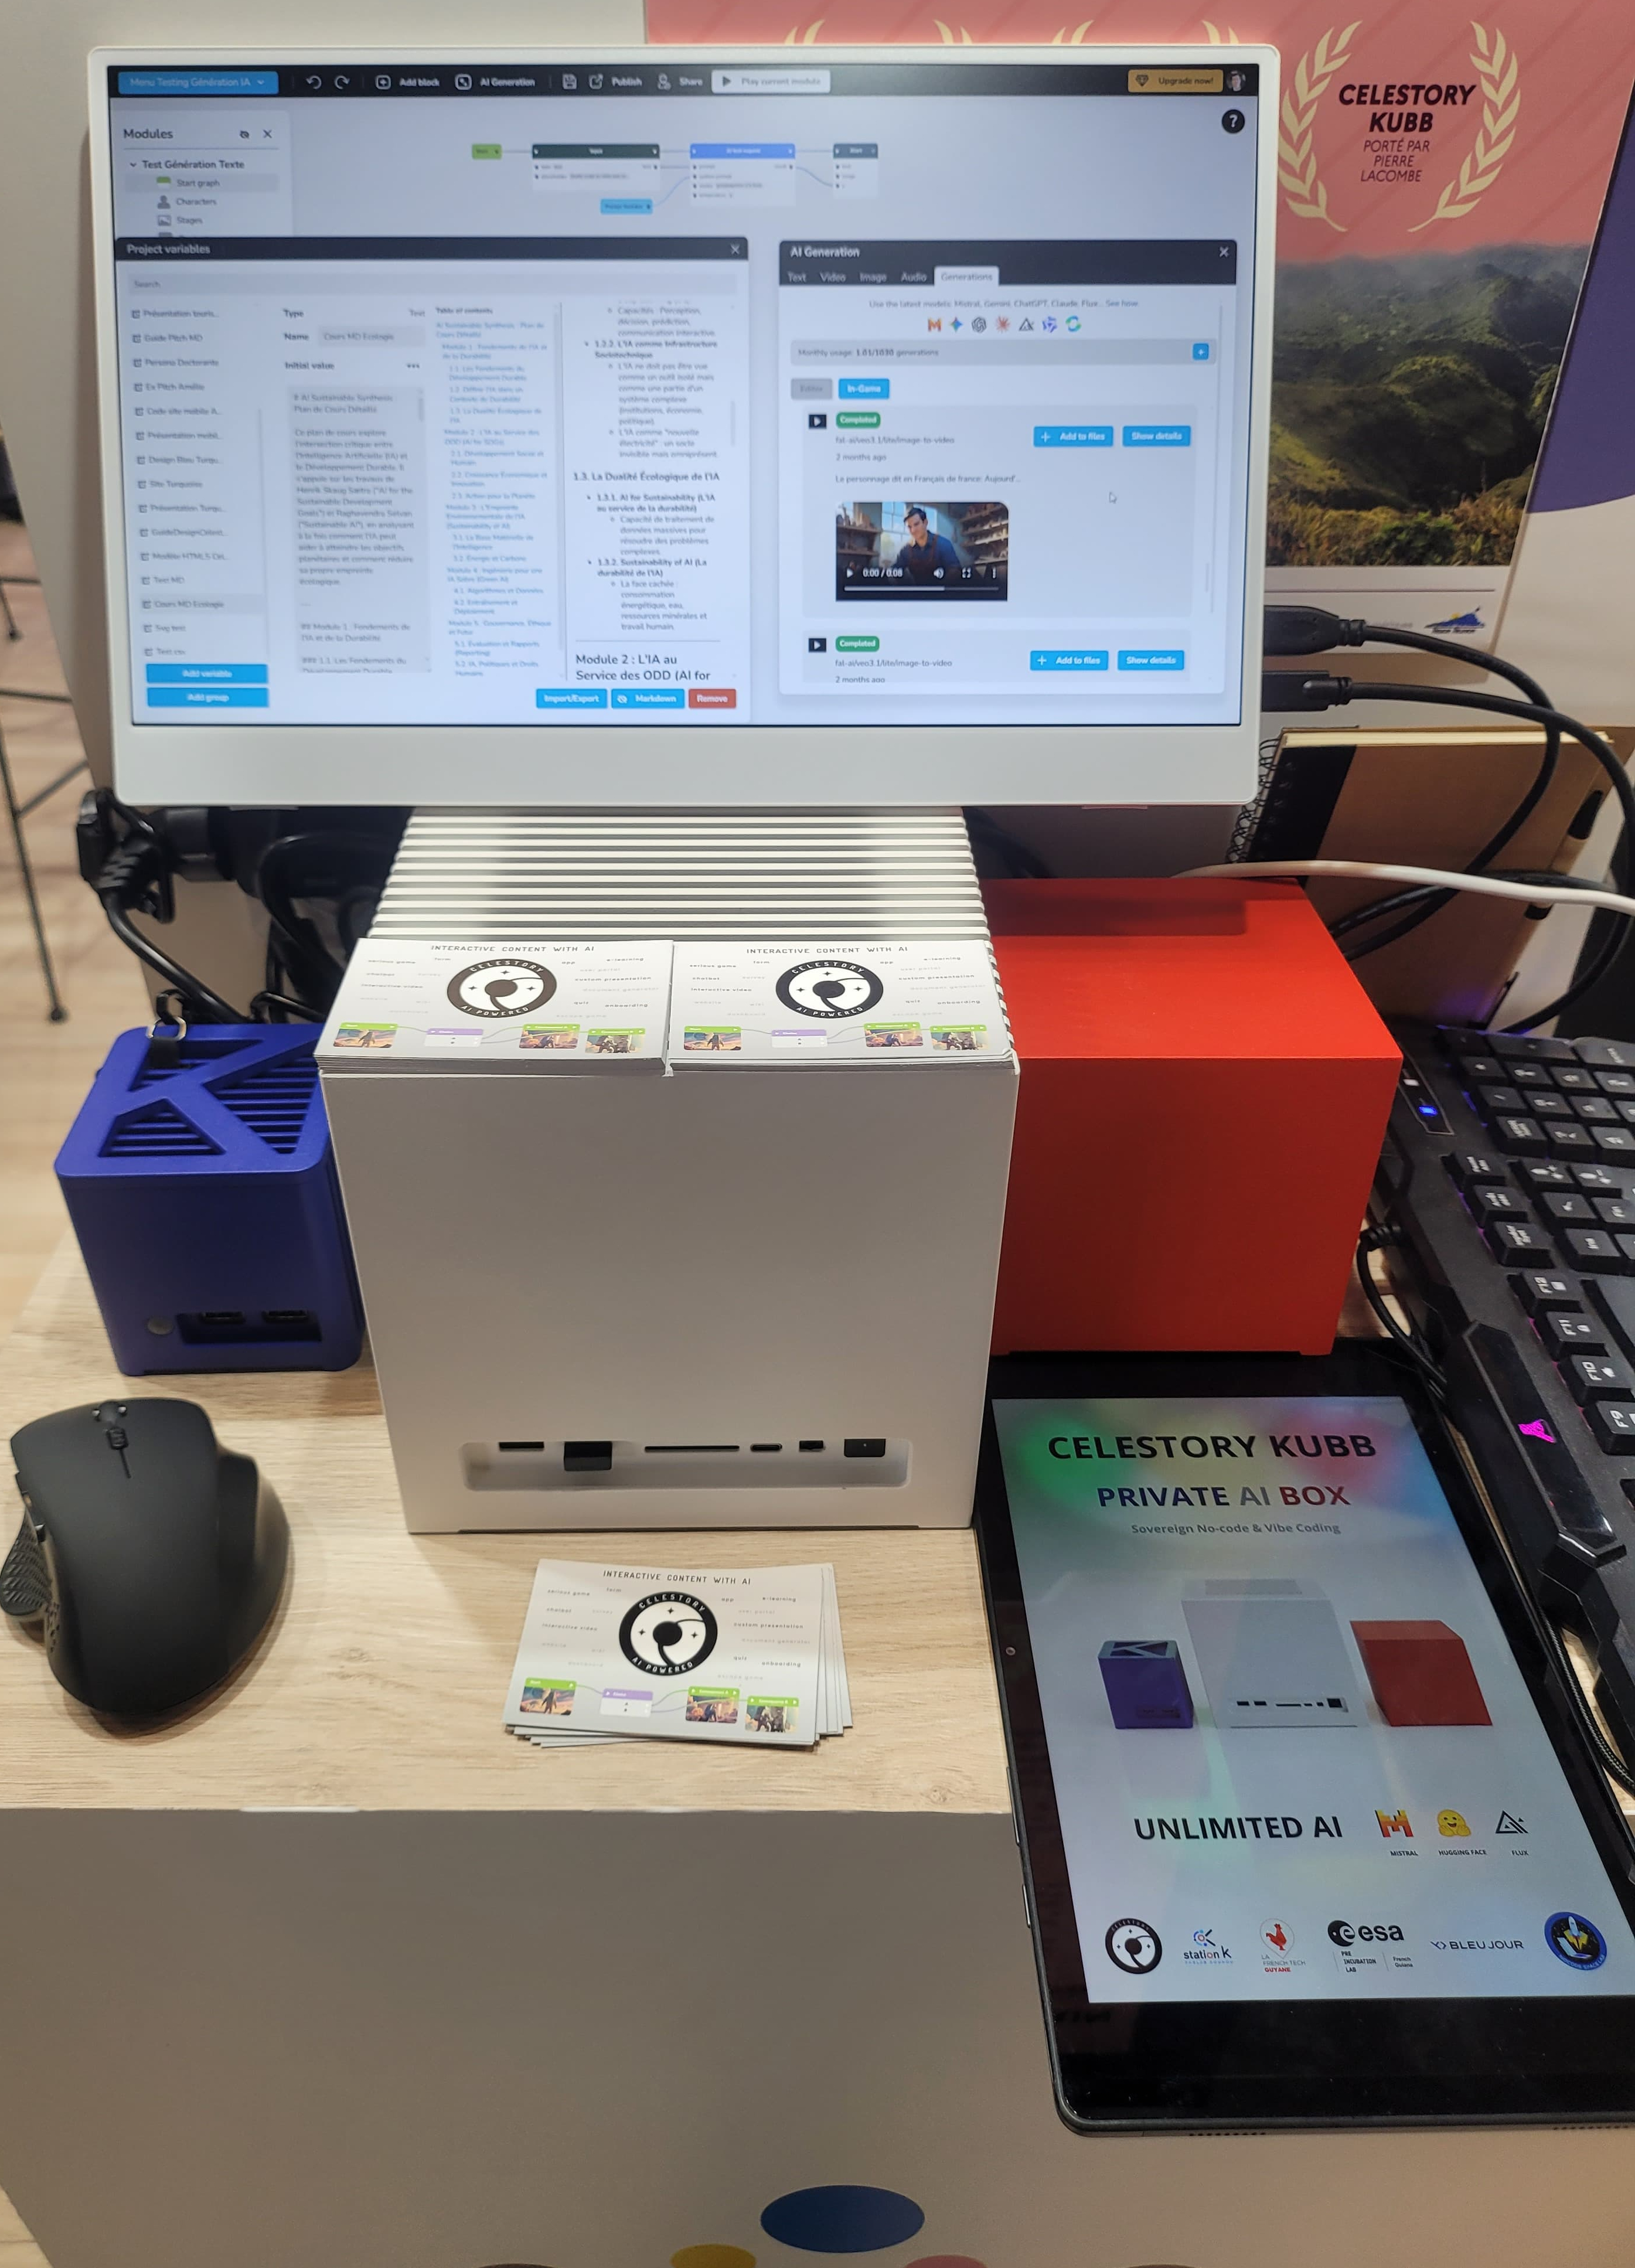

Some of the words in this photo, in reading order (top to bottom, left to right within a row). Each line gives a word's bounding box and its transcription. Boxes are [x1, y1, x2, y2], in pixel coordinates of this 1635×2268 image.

[130, 79, 154, 87] Menu
[158, 77, 189, 88] Testing
[190, 77, 239, 87] Génération
[240, 78, 251, 87] IA
[491, 77, 535, 86] Generation
[612, 77, 642, 86] Publish
[680, 77, 703, 87] Share
[741, 77, 759, 87] Play
[791, 77, 822, 87] module
[1159, 77, 1192, 86] Upgrade
[1339, 84, 1476, 105] CELESTORY
[1369, 112, 1433, 132] KUBB
[123, 129, 173, 139] Modules
[1363, 137, 1404, 152] PORTÉ
[1407, 140, 1430, 152] PAR
[141, 160, 162, 169] Test
[164, 160, 216, 169] Génération
[219, 160, 246, 168] Texte
[1374, 155, 1415, 167] PIERRE
[1361, 170, 1422, 182] LACOMBE
[177, 179, 196, 187] Start
[197, 180, 220, 188] graph
[176, 216, 203, 225] Stages
[127, 244, 163, 256] Project
[164, 244, 210, 254] variables
[790, 247, 802, 257] AI
[803, 246, 860, 258] Generation
[787, 273, 806, 282] Text
[819, 272, 846, 282] Video
[859, 273, 887, 284] Image
[901, 272, 927, 282] Audio
[941, 272, 993, 281] Generations
[847, 384, 881, 393] In-Game
[840, 416, 877, 425] Completed
[1060, 432, 1077, 440] Add
[1132, 432, 1154, 440] Show
[574, 472, 590, 481] 1.3.
[591, 472, 603, 481] La
[605, 472, 638, 481] Dualité
[640, 471, 689, 482] Écologique
[692, 472, 703, 481] de
[863, 567, 879, 577] 0:00
[886, 568, 903, 577] 0:08
[839, 639, 876, 648] Completed
[576, 654, 618, 664] Module
[622, 655, 628, 664] 2
[638, 654, 660, 664] L'IA
[1055, 656, 1072, 665] Add
[576, 670, 616, 680] Service
[621, 670, 640, 680] des
[643, 670, 671, 680] ODD
[675, 670, 691, 681] (AI
[694, 670, 710, 680] for
[544, 694, 599, 703] Import/Export
[469, 960, 545, 973] CELESTORY
[792, 961, 865, 975] CELESTORY
[459, 1004, 472, 1013] AI
[476, 1006, 530, 1017] POWERED
[796, 1006, 809, 1014] AI
[813, 1006, 864, 1018] POWERED
[1534, 1277, 1553, 1294] F12
[1558, 1319, 1577, 1336] F11
[1582, 1361, 1602, 1381] F10
[1610, 1410, 1629, 1428] F9
[1048, 1435, 1256, 1459] CELESTORY
[1270, 1435, 1377, 1459] KUBB
[1097, 1486, 1231, 1507] PRIVATE
[1239, 1486, 1271, 1506] AI
[1279, 1485, 1351, 1506] BOX
[1132, 1524, 1194, 1535] Sovereign
[1197, 1524, 1249, 1533] No-code
[1252, 1524, 1262, 1532] &
[1264, 1524, 1293, 1532] Vibe
[1296, 1523, 1341, 1534] Coding
[603, 1571, 661, 1580] INTERACTIVE
[667, 1575, 707, 1583] CONTENT
[638, 1594, 706, 1612] CELESTORY
[632, 1656, 642, 1665] AI
[646, 1661, 694, 1674] POWERED
[1134, 1817, 1303, 1840] UNLIMITED
[1314, 1816, 1343, 1838] AI
[1358, 1925, 1404, 1942] esa
[1183, 1949, 1220, 1960] station
